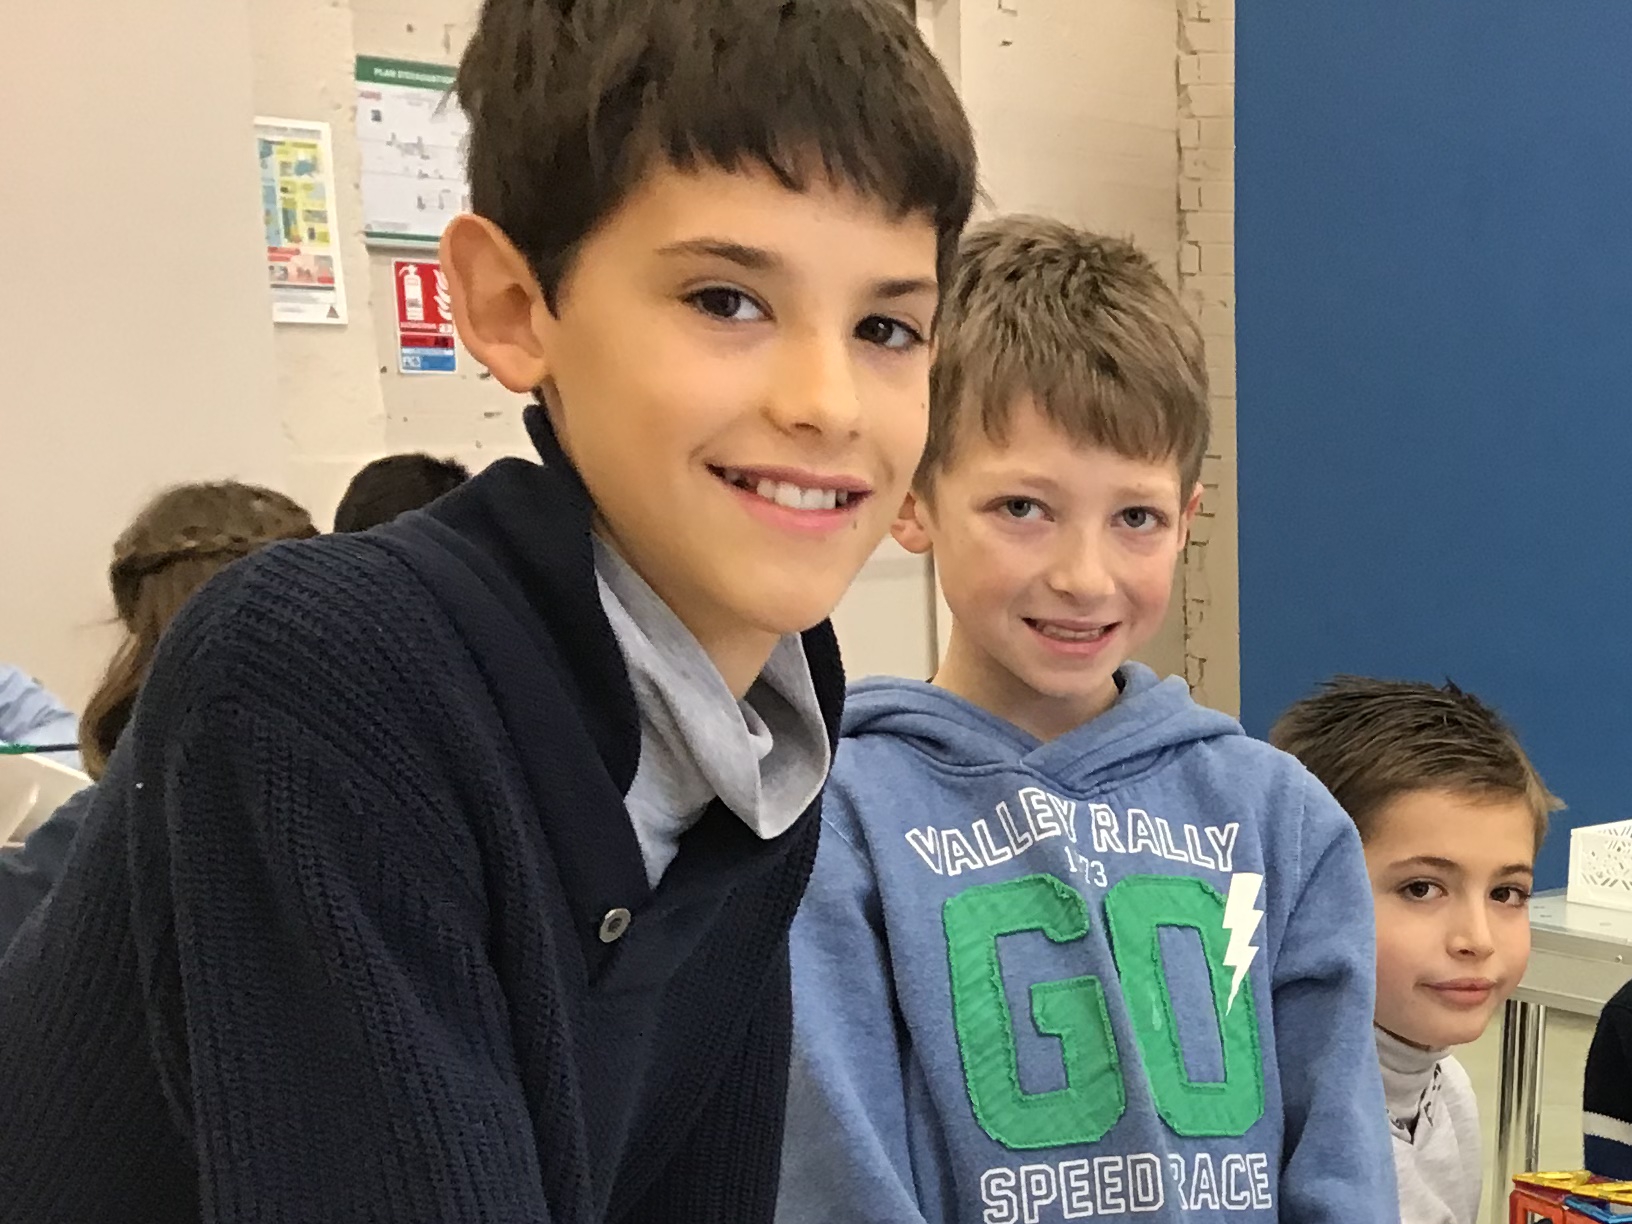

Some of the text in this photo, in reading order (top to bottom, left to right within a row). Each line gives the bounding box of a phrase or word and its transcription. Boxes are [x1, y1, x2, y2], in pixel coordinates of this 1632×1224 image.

[905, 787, 1239, 877] VALLEY RALLY
[1064, 846, 1108, 888] 173
[943, 873, 1265, 1149] GO
[1167, 1153, 1272, 1210] RACE
